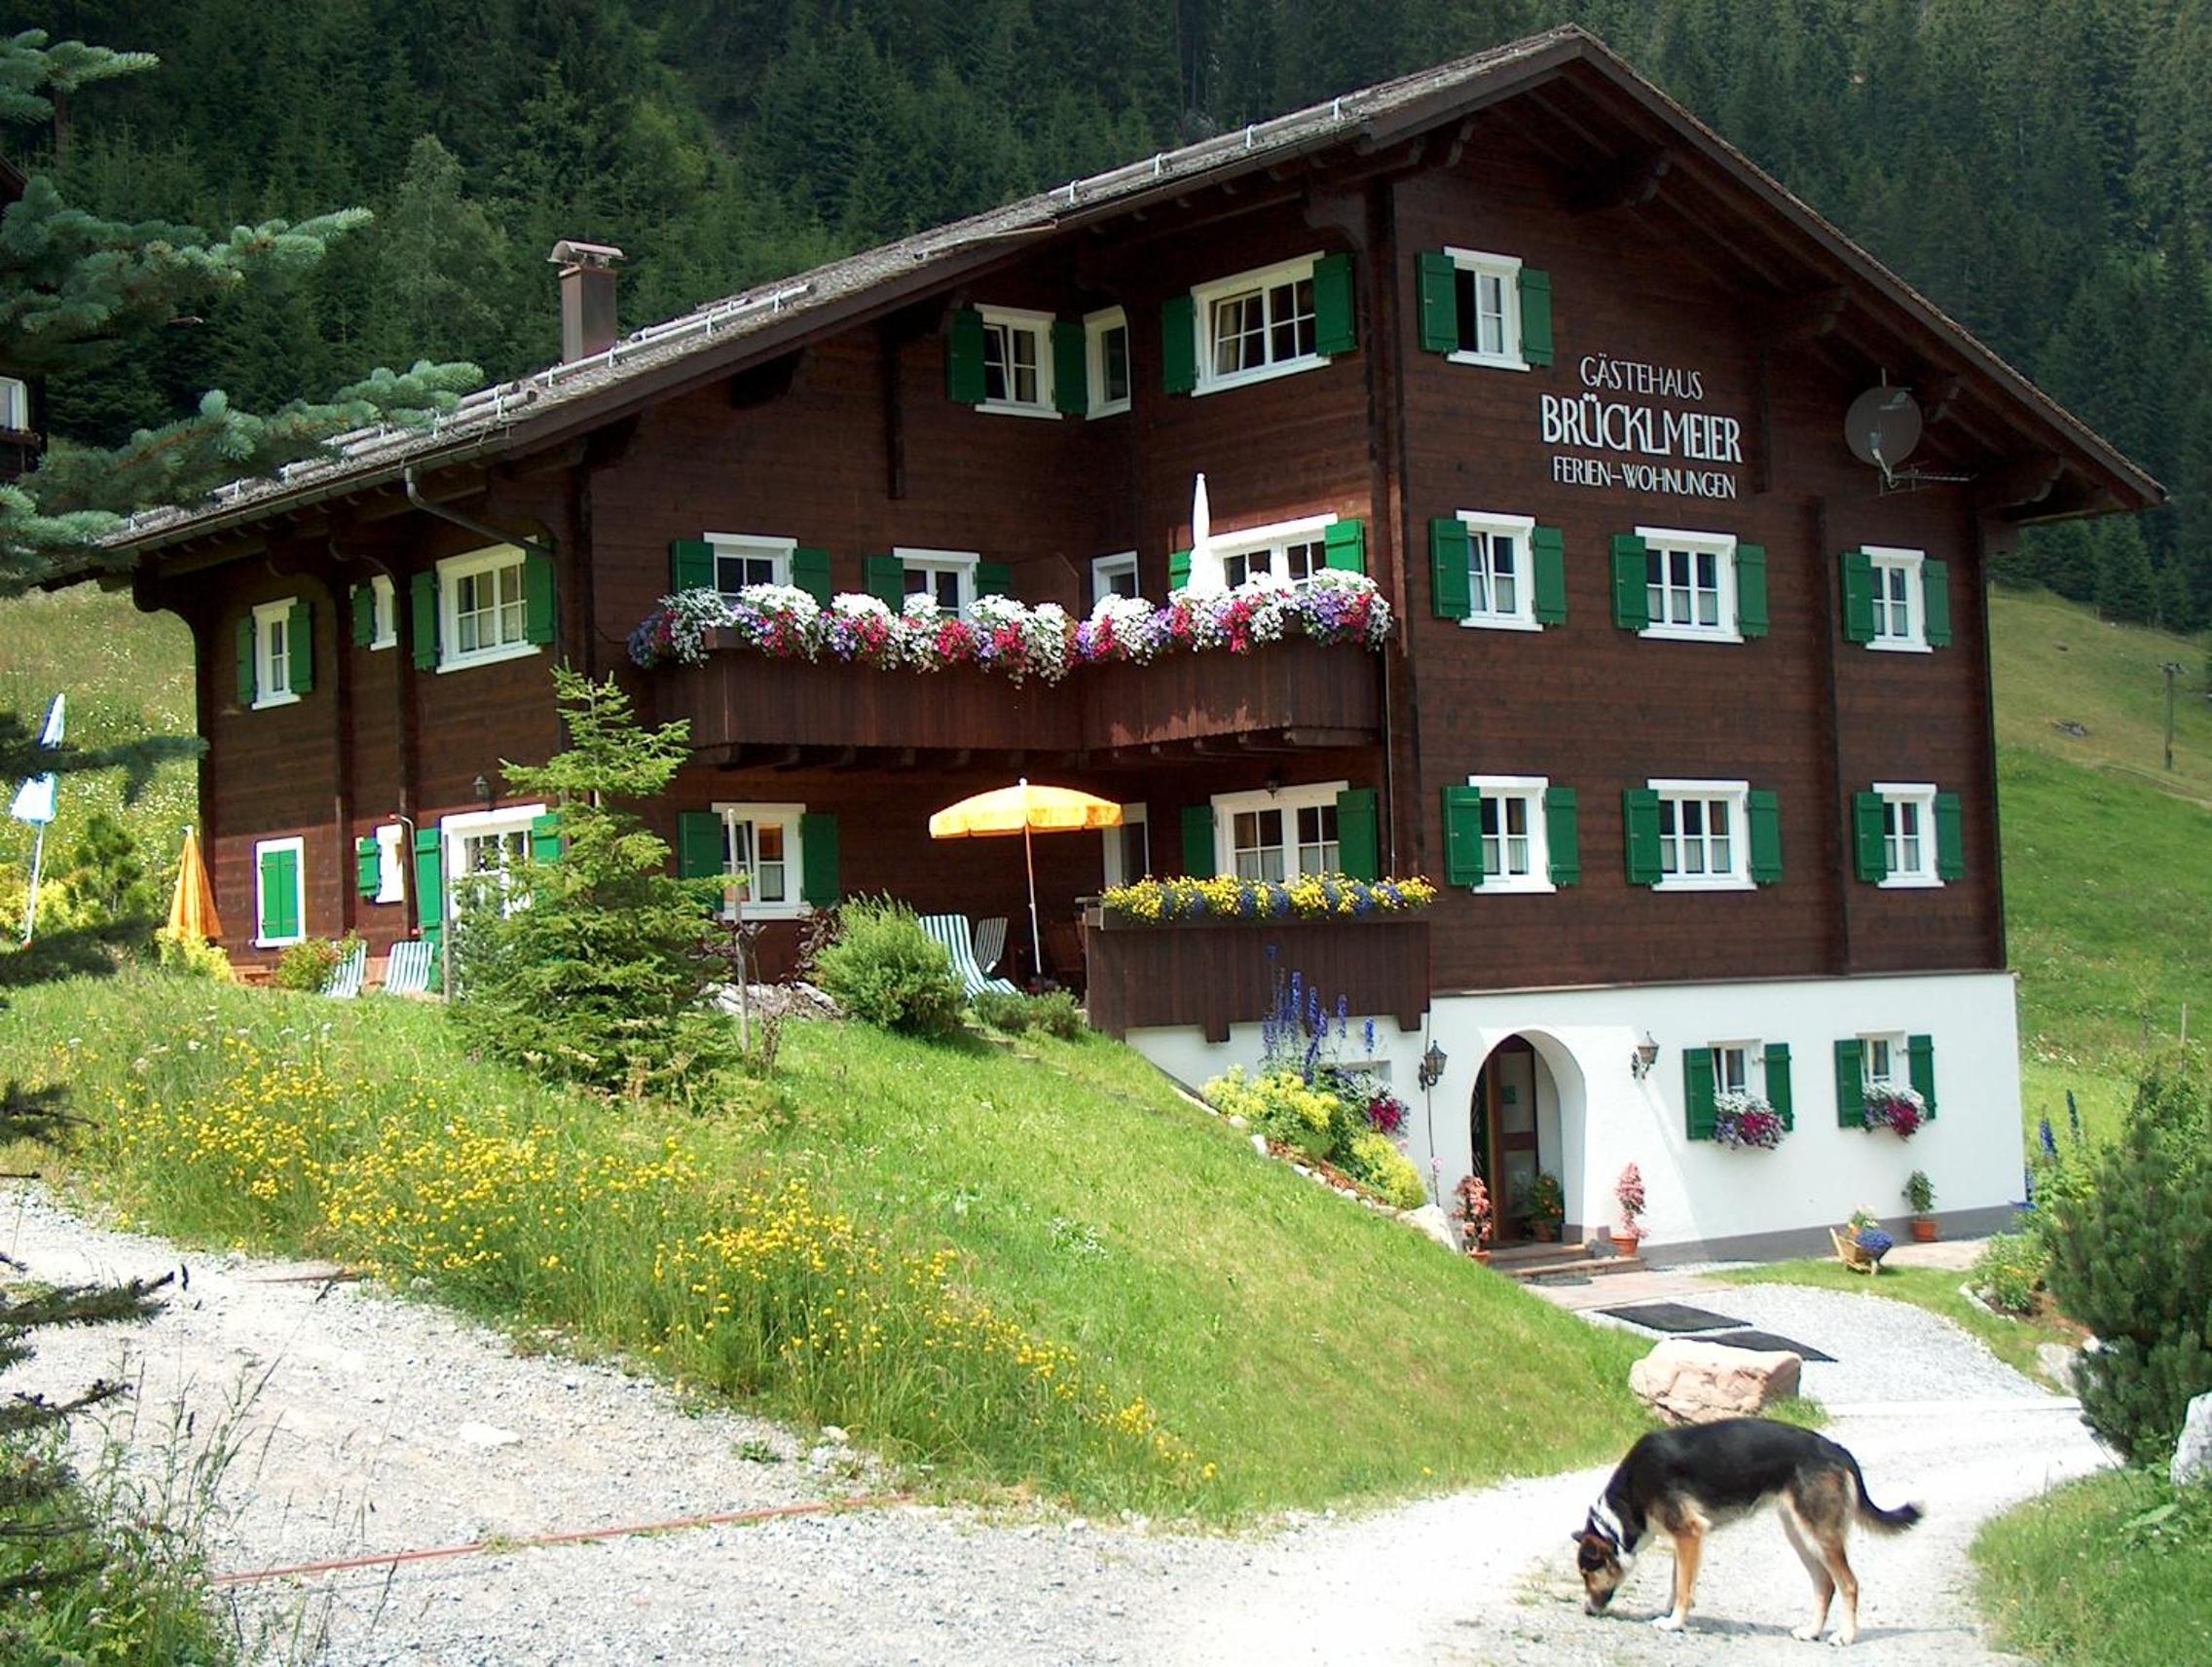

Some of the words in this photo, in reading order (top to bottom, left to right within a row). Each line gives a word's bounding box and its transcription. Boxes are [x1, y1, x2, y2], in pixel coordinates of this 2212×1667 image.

[1580, 352, 1703, 400] GÄSTEHAUS
[1541, 392, 1743, 463] BRÜCKLMEIER
[1553, 456, 1736, 499] FERIEN-WOHNUNGEN
